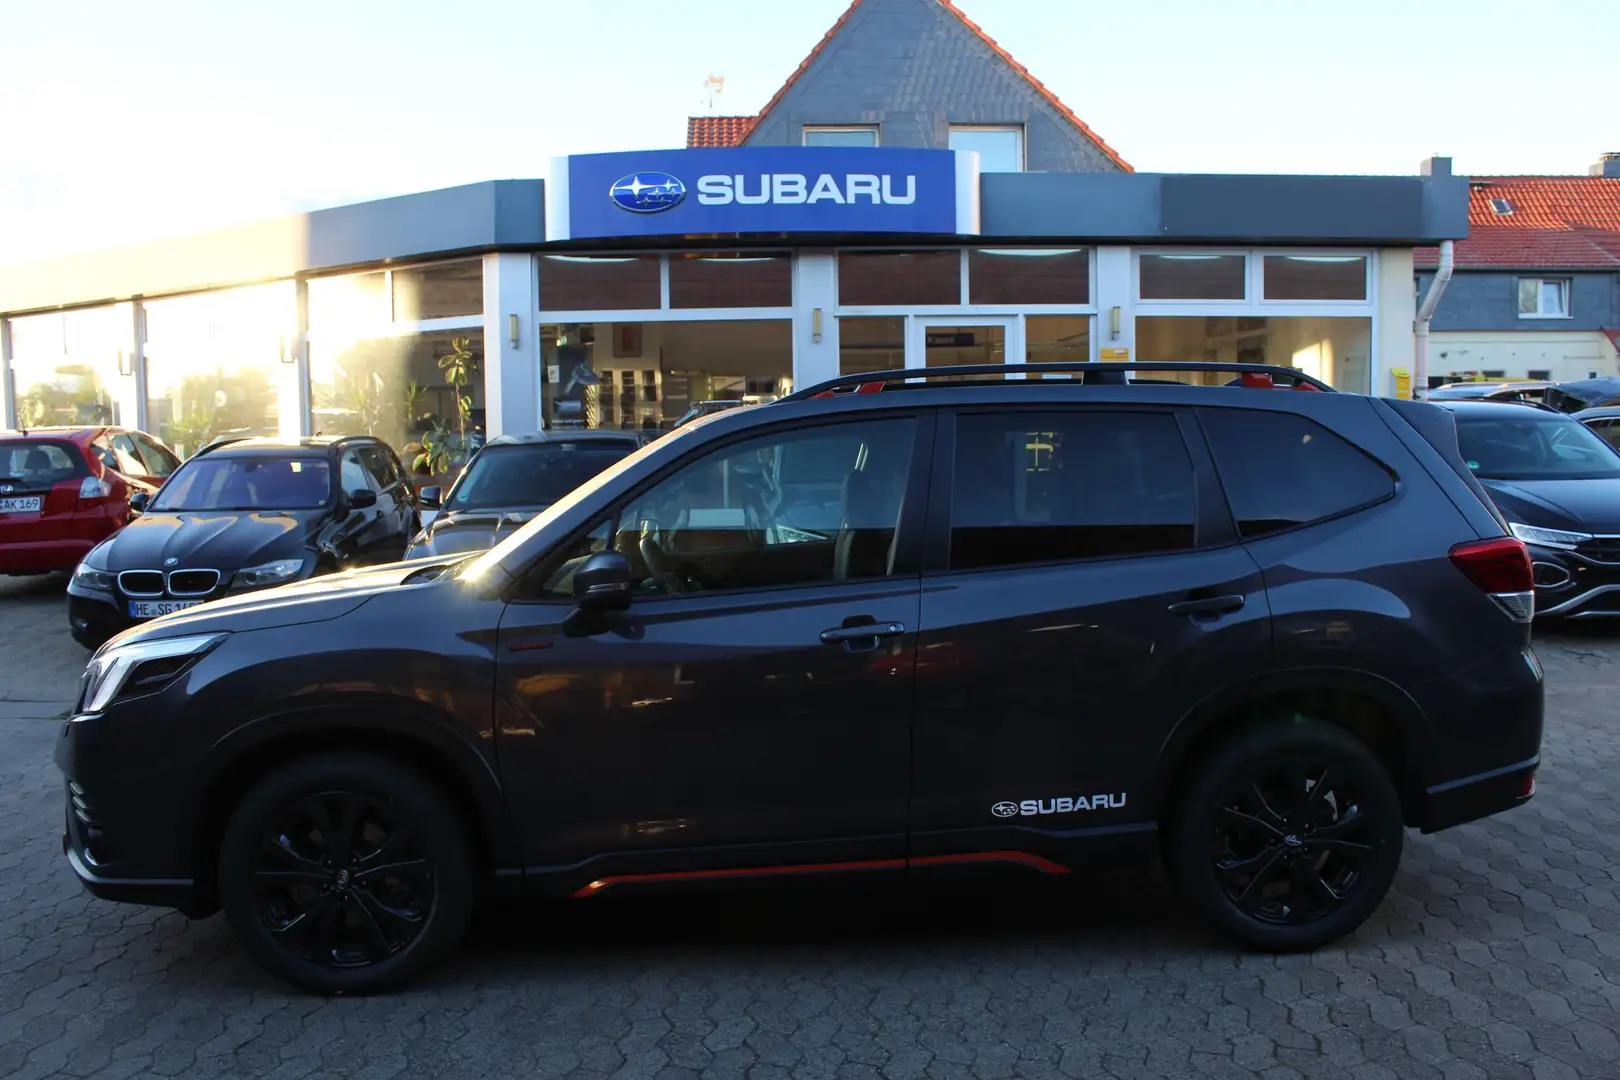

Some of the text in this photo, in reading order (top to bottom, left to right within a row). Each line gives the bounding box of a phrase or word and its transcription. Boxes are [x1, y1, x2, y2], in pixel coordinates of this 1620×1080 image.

[697, 174, 916, 205] SUBARU
[4, 498, 39, 509] AK 169
[136, 603, 149, 616] HE
[158, 603, 172, 615] SG
[1020, 792, 1126, 816] SUBARU
